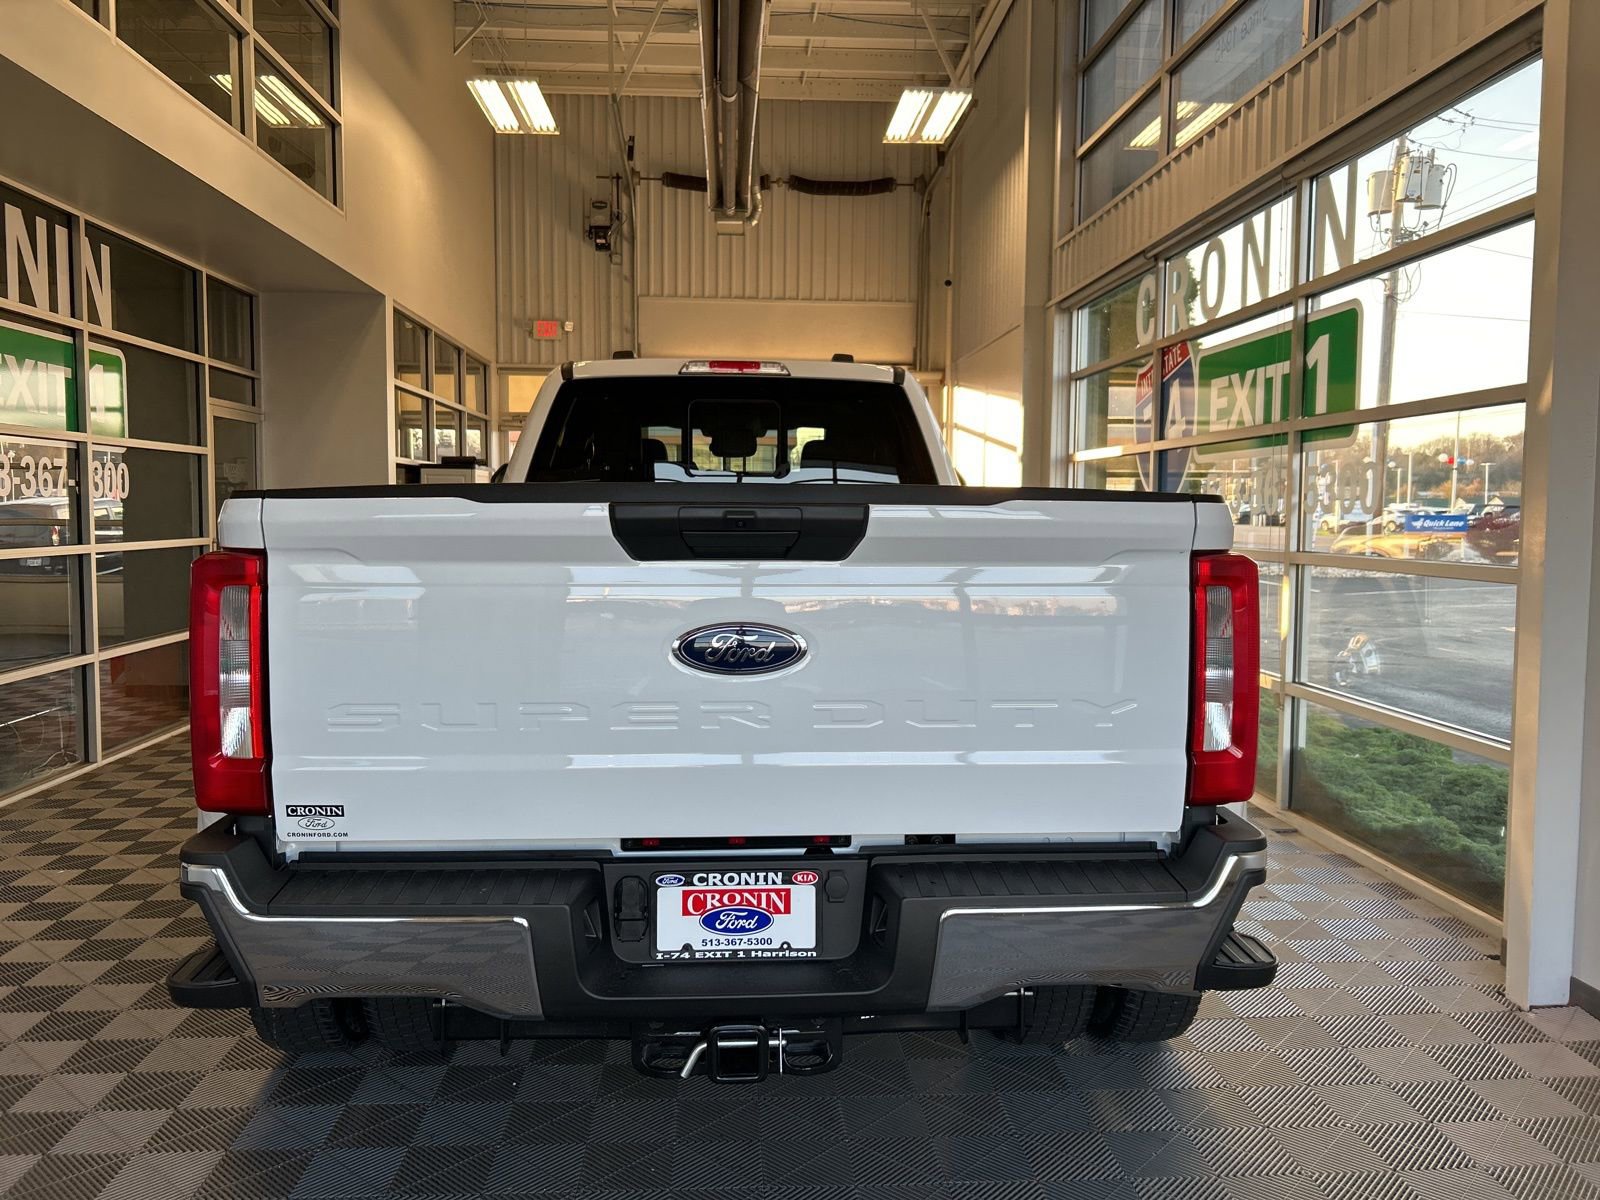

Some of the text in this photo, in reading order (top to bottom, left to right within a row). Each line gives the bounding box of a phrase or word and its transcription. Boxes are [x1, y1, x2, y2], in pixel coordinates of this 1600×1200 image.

[1136, 160, 1358, 345] CRONN
[0, 354, 72, 417] XIT
[1209, 333, 1331, 433] EXIT 1
[1423, 519, 1464, 527] Quick Lane
[704, 633, 776, 664] Ford
[326, 699, 1139, 732] SUPER DUTY
[287, 806, 343, 816] CRONIN
[305, 818, 328, 828] Ford
[692, 872, 783, 886] CRONIN
[796, 873, 815, 883] KIA
[686, 891, 787, 915] CRONIN
[715, 910, 758, 930] Ford
[701, 937, 773, 947] 513-367-5300
[656, 950, 817, 960] I-74 EXIT 1 Harrison
